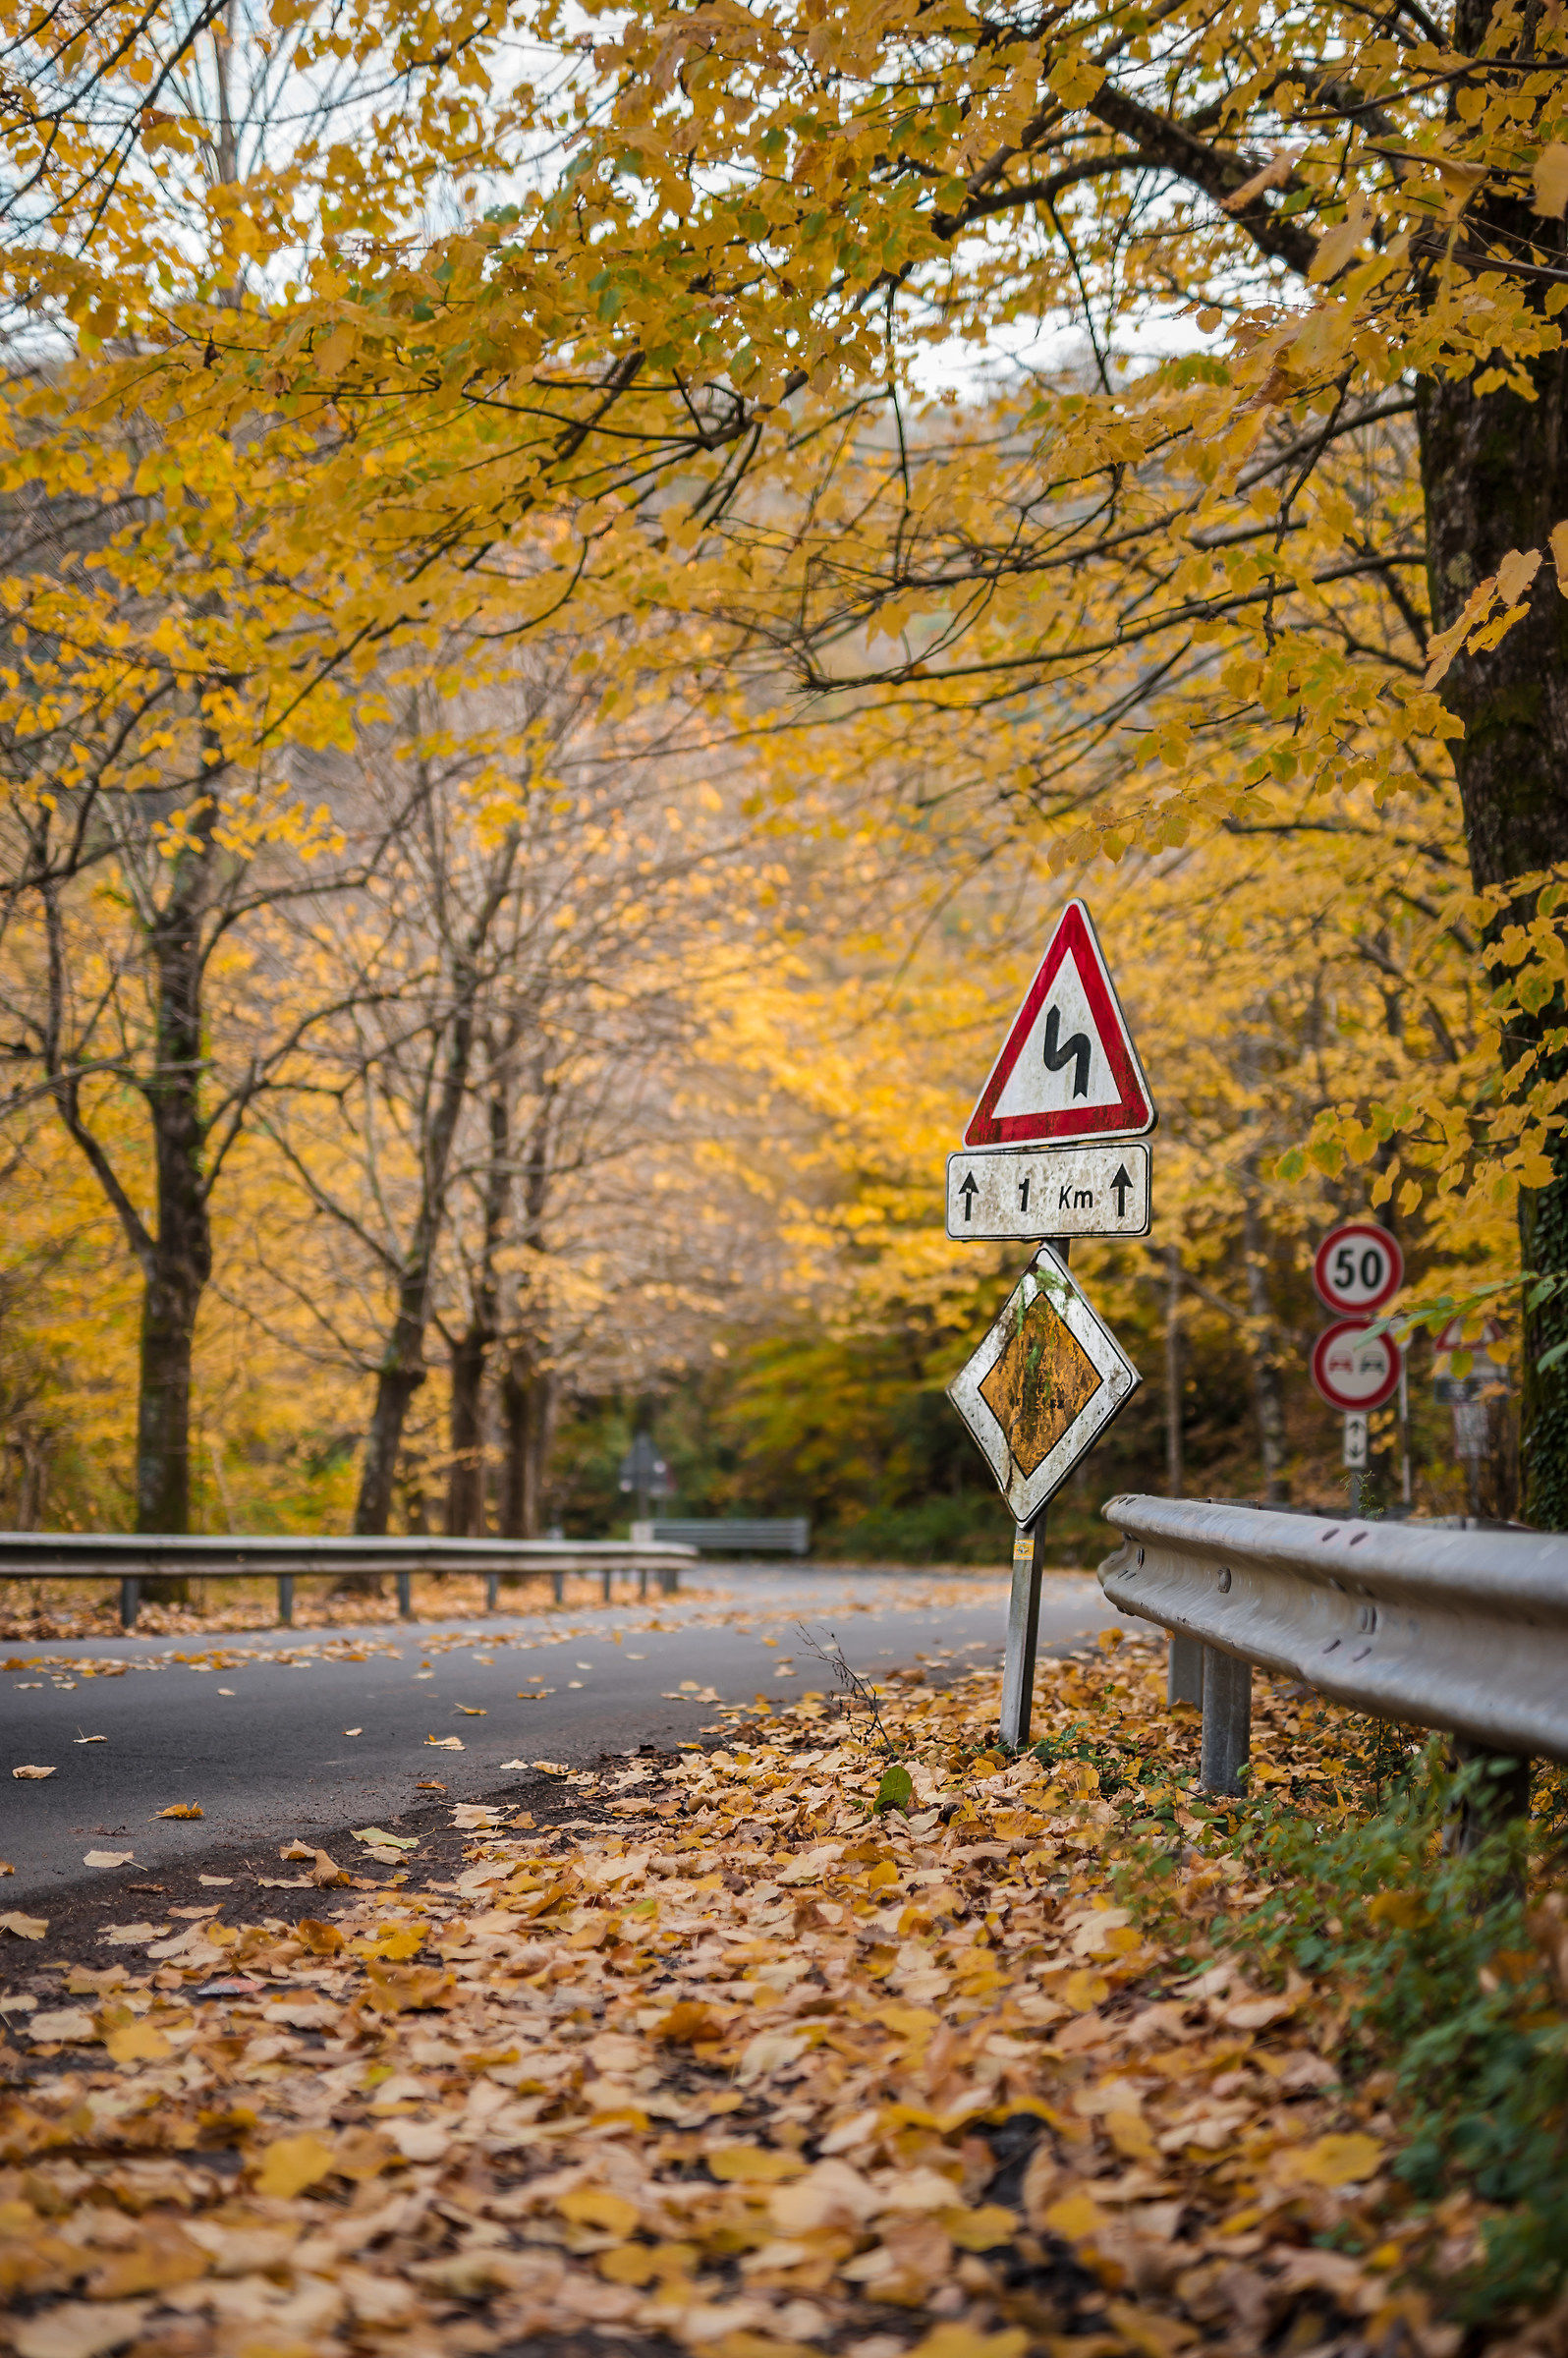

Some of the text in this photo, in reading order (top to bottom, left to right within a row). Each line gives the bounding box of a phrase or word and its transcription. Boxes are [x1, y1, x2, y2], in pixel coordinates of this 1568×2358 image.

[1018, 1178, 1093, 1212] 1 Km
[1333, 1249, 1382, 1289] 50
